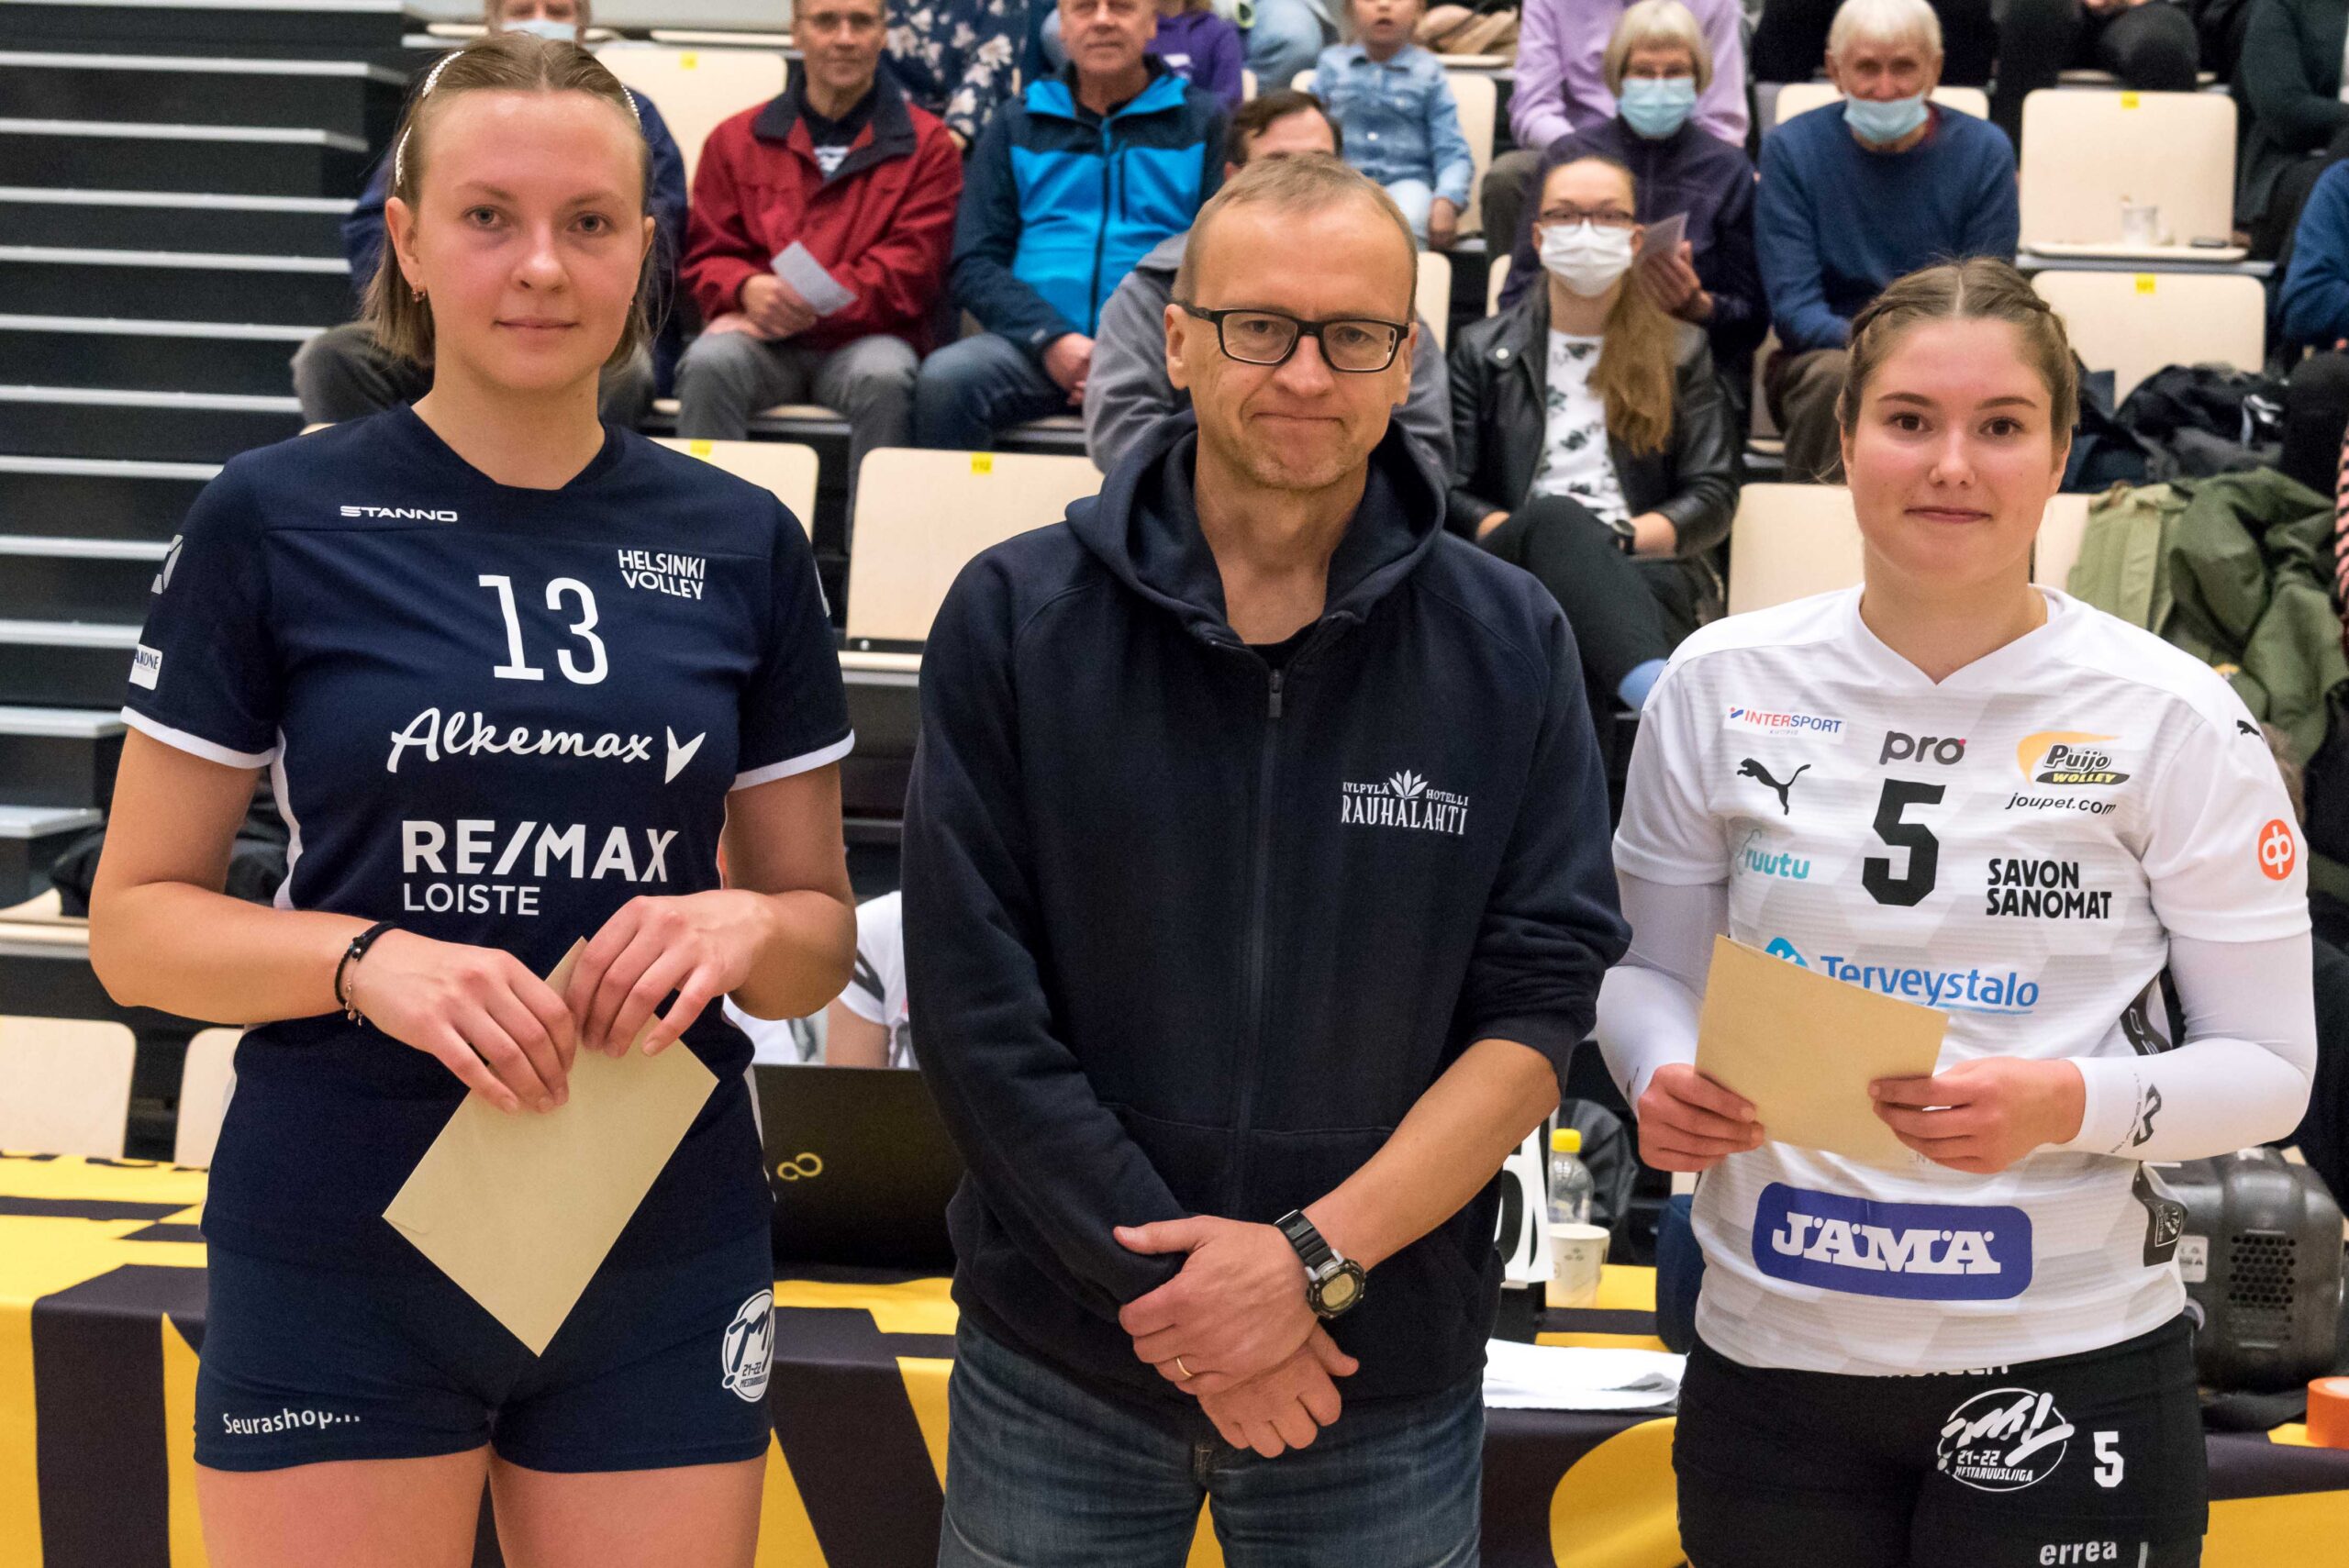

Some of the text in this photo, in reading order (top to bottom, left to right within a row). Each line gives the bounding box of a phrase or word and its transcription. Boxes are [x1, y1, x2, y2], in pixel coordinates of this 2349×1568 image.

[340, 506, 459, 522] STANNO
[618, 549, 707, 580] HELSINKI
[621, 570, 704, 600] VOLLEY
[478, 574, 609, 685] 13
[1744, 709, 1842, 734] INTERSPORT
[386, 706, 653, 773] Alkemax
[1879, 730, 1966, 765] pro
[2044, 743, 2112, 773] Puijo
[1342, 782, 1390, 795] KYLPYLÄ
[2052, 773, 2118, 784] WOLLEY
[1425, 788, 1469, 806] HOTELLI
[2005, 793, 2117, 816] joupet.com
[1341, 794, 1468, 836] RAUHALAHTI
[402, 819, 679, 883] RE/MAX
[1862, 778, 1946, 907] 5
[1987, 858, 2079, 889] SAVON
[404, 883, 540, 916] LOISTE
[1986, 887, 2112, 918] SANOMAT
[1820, 955, 2039, 1007] Terveystalo
[1957, 1450, 2001, 1466] 21-22
[2093, 1430, 2124, 1488] 5
[2039, 1540, 2118, 1566] errea
